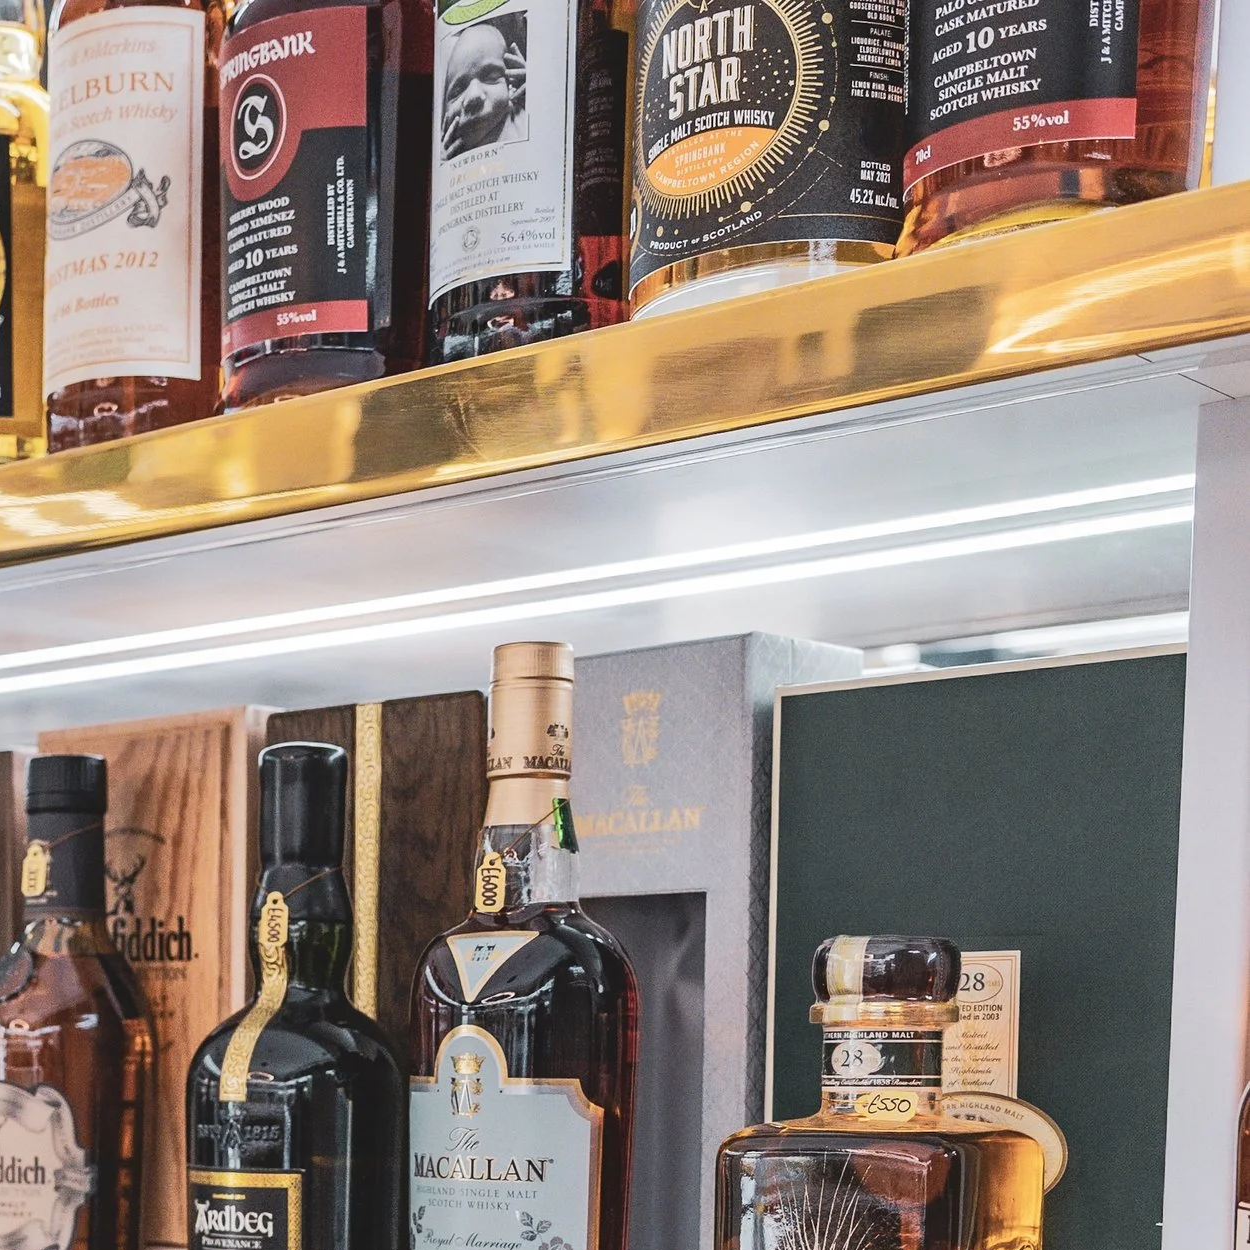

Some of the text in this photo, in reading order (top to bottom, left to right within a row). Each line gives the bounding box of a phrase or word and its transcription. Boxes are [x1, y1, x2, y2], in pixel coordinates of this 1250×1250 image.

[850, 2, 889, 14] GOOSEBERRIES
[867, 12, 895, 23] OLD BOOKS
[935, 0, 1039, 37] CASK MATURED
[662, 5, 755, 79] NORTH
[851, 36, 882, 47] LIQUORICE,
[870, 27, 892, 38] PALATE:
[932, 19, 1047, 64] AGED 10 YEARS
[857, 54, 901, 67] SHERBERT LEMON
[859, 45, 895, 57] ELDERFLOWER
[870, 71, 889, 81] FINISH:
[933, 47, 1037, 88] CAMPBELTOWN
[669, 57, 742, 120] STAR
[851, 80, 903, 95] LEMON BEACH
[938, 65, 1029, 101] SINGLE MALT
[851, 89, 903, 103] FIRE DRIED HERBS
[929, 78, 1042, 121] SCOTCH WHISKY
[70, 104, 178, 132] Scotch Whisky
[238, 95, 274, 160] S
[1013, 110, 1069, 132] 55%vol
[648, 109, 775, 164] SINGLE MALT SCOTCH WHISKY
[655, 140, 759, 189] CAMPBELTOWN REGION
[675, 141, 726, 168] SPRINGBANK
[915, 145, 932, 164] 70cl
[676, 157, 724, 177] DISTILLERY
[861, 160, 891, 171] BOTTLED
[449, 171, 540, 201] MALT SCOTCH WHISKY
[860, 170, 891, 184] MAY 2021
[450, 191, 500, 215] DISTILLED AT
[850, 188, 874, 204] 45.2%
[229, 196, 290, 226] SHERRY WOOD
[250, 209, 296, 230] XIMÉNEZ
[327, 183, 335, 246] DISTILLED BY
[346, 179, 354, 249] CAMPBELTOWN
[475, 201, 525, 221] DISTILLERY
[244, 225, 292, 248] MATURED
[500, 227, 556, 246] 56.4%vol
[650, 211, 763, 250] PRODUCT SCOTLAND
[114, 251, 159, 269] 2012
[244, 248, 264, 270] 10
[265, 244, 298, 260] YEARS
[228, 267, 292, 295] CAMPBELTOWN
[74, 292, 121, 313] Bottles
[231, 280, 287, 306] SINGLE MALT
[227, 290, 296, 320] SCOTCH WHISKY
[277, 309, 317, 326] 55%vol
[575, 806, 703, 837] MACALLAN
[959, 972, 986, 992] 28
[973, 1004, 1003, 1013] EDITION
[973, 1013, 1000, 1021] in 2003
[843, 1031, 915, 1039] HIGHLAND MALT
[841, 1049, 863, 1067] 28
[960, 1102, 1025, 1121] HIGHLAND MALT
[447, 1126, 481, 1152] The
[414, 1152, 549, 1183] MACALLAN
[417, 1185, 538, 1199] HIGHLAND SINGLE MALT
[428, 1199, 511, 1211] SCOTCH WHISKY
[423, 1229, 456, 1249] Royal
